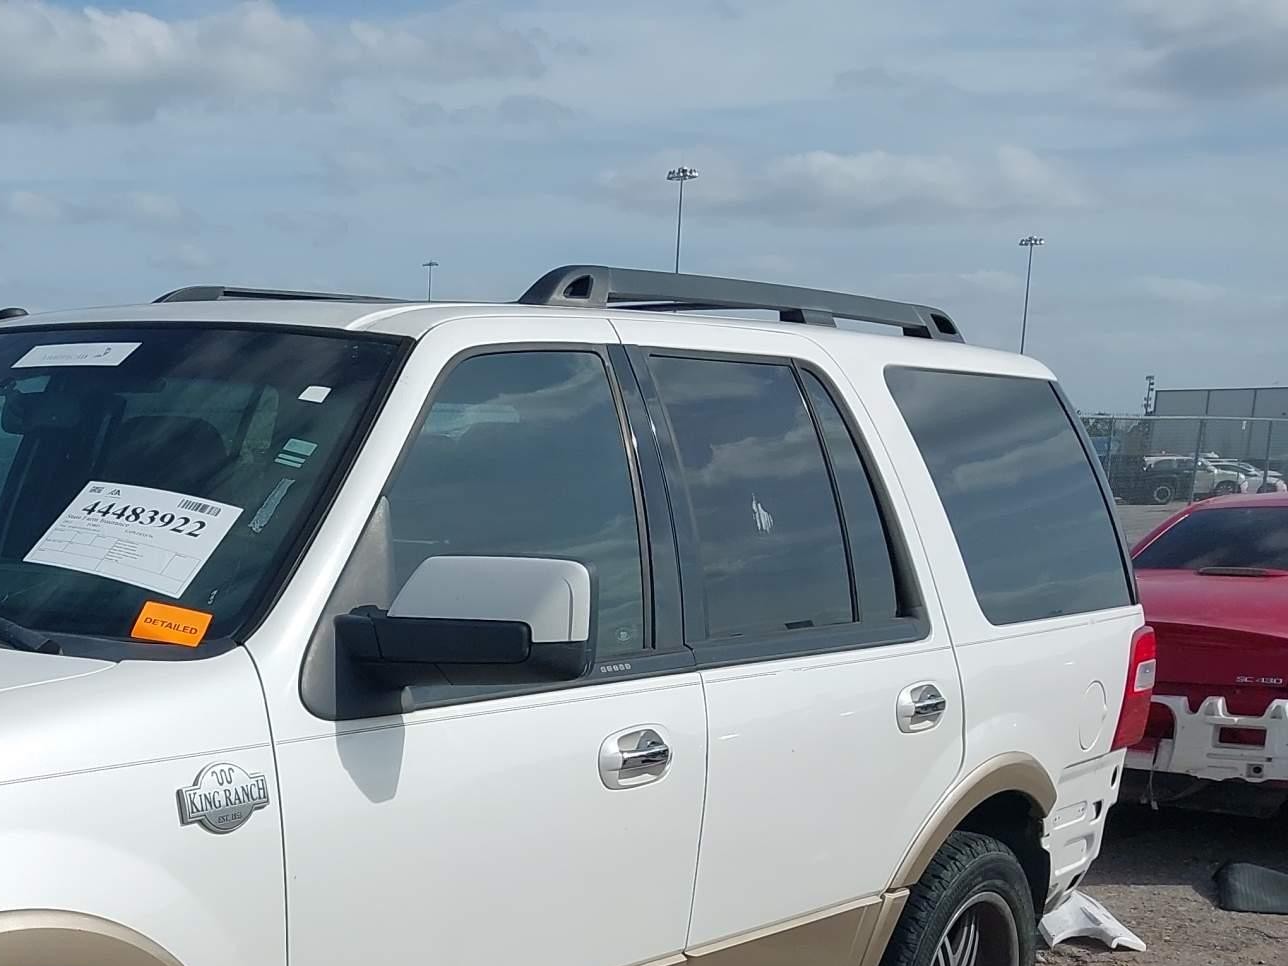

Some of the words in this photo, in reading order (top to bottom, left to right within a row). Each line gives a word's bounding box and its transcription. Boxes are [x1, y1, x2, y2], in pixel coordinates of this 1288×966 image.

[81, 500, 207, 538] 44483922
[143, 616, 198, 635] DETAILED
[1235, 676, 1254, 684] SC
[188, 790, 222, 814] KING
[224, 778, 267, 808] RANCH
